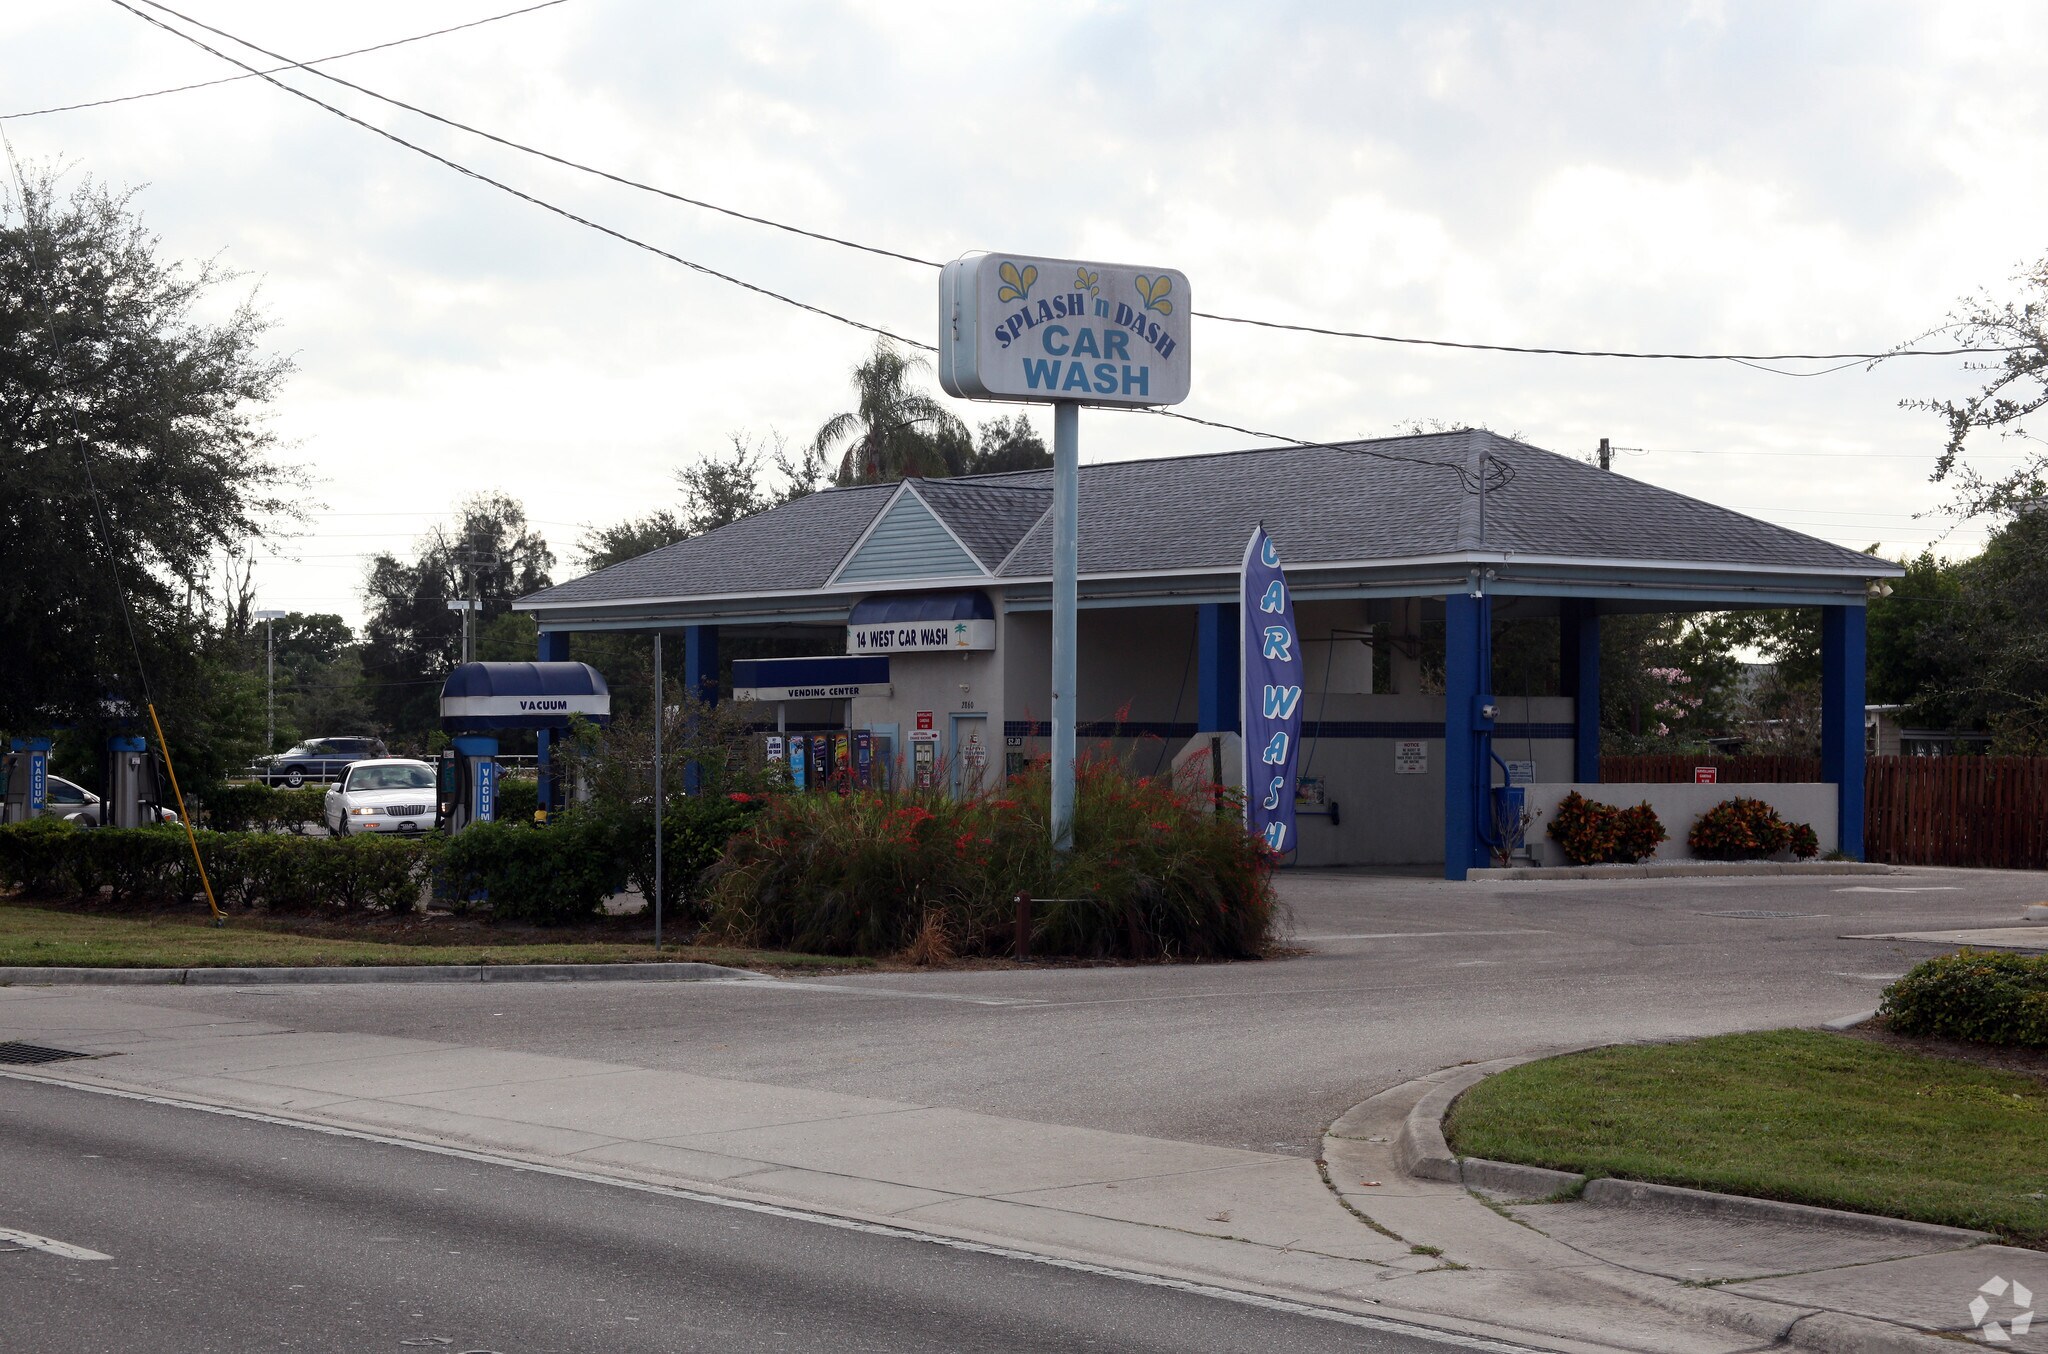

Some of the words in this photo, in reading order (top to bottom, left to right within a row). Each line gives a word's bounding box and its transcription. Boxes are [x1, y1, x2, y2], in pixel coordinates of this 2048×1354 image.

[994, 293, 1085, 349] SPLASH
[1114, 301, 1177, 360] DASH
[1042, 324, 1131, 361] CAR
[1022, 357, 1149, 397] WASH
[856, 631, 867, 648] 14
[870, 630, 895, 648] WEST
[898, 629, 917, 646] CAR
[920, 628, 948, 646] WASH
[520, 701, 567, 711] VACUUM
[788, 688, 825, 698] VENDING
[829, 686, 860, 696] CENTER
[34, 760, 42, 804] VACUUM
[481, 768, 490, 821] VACUUM
